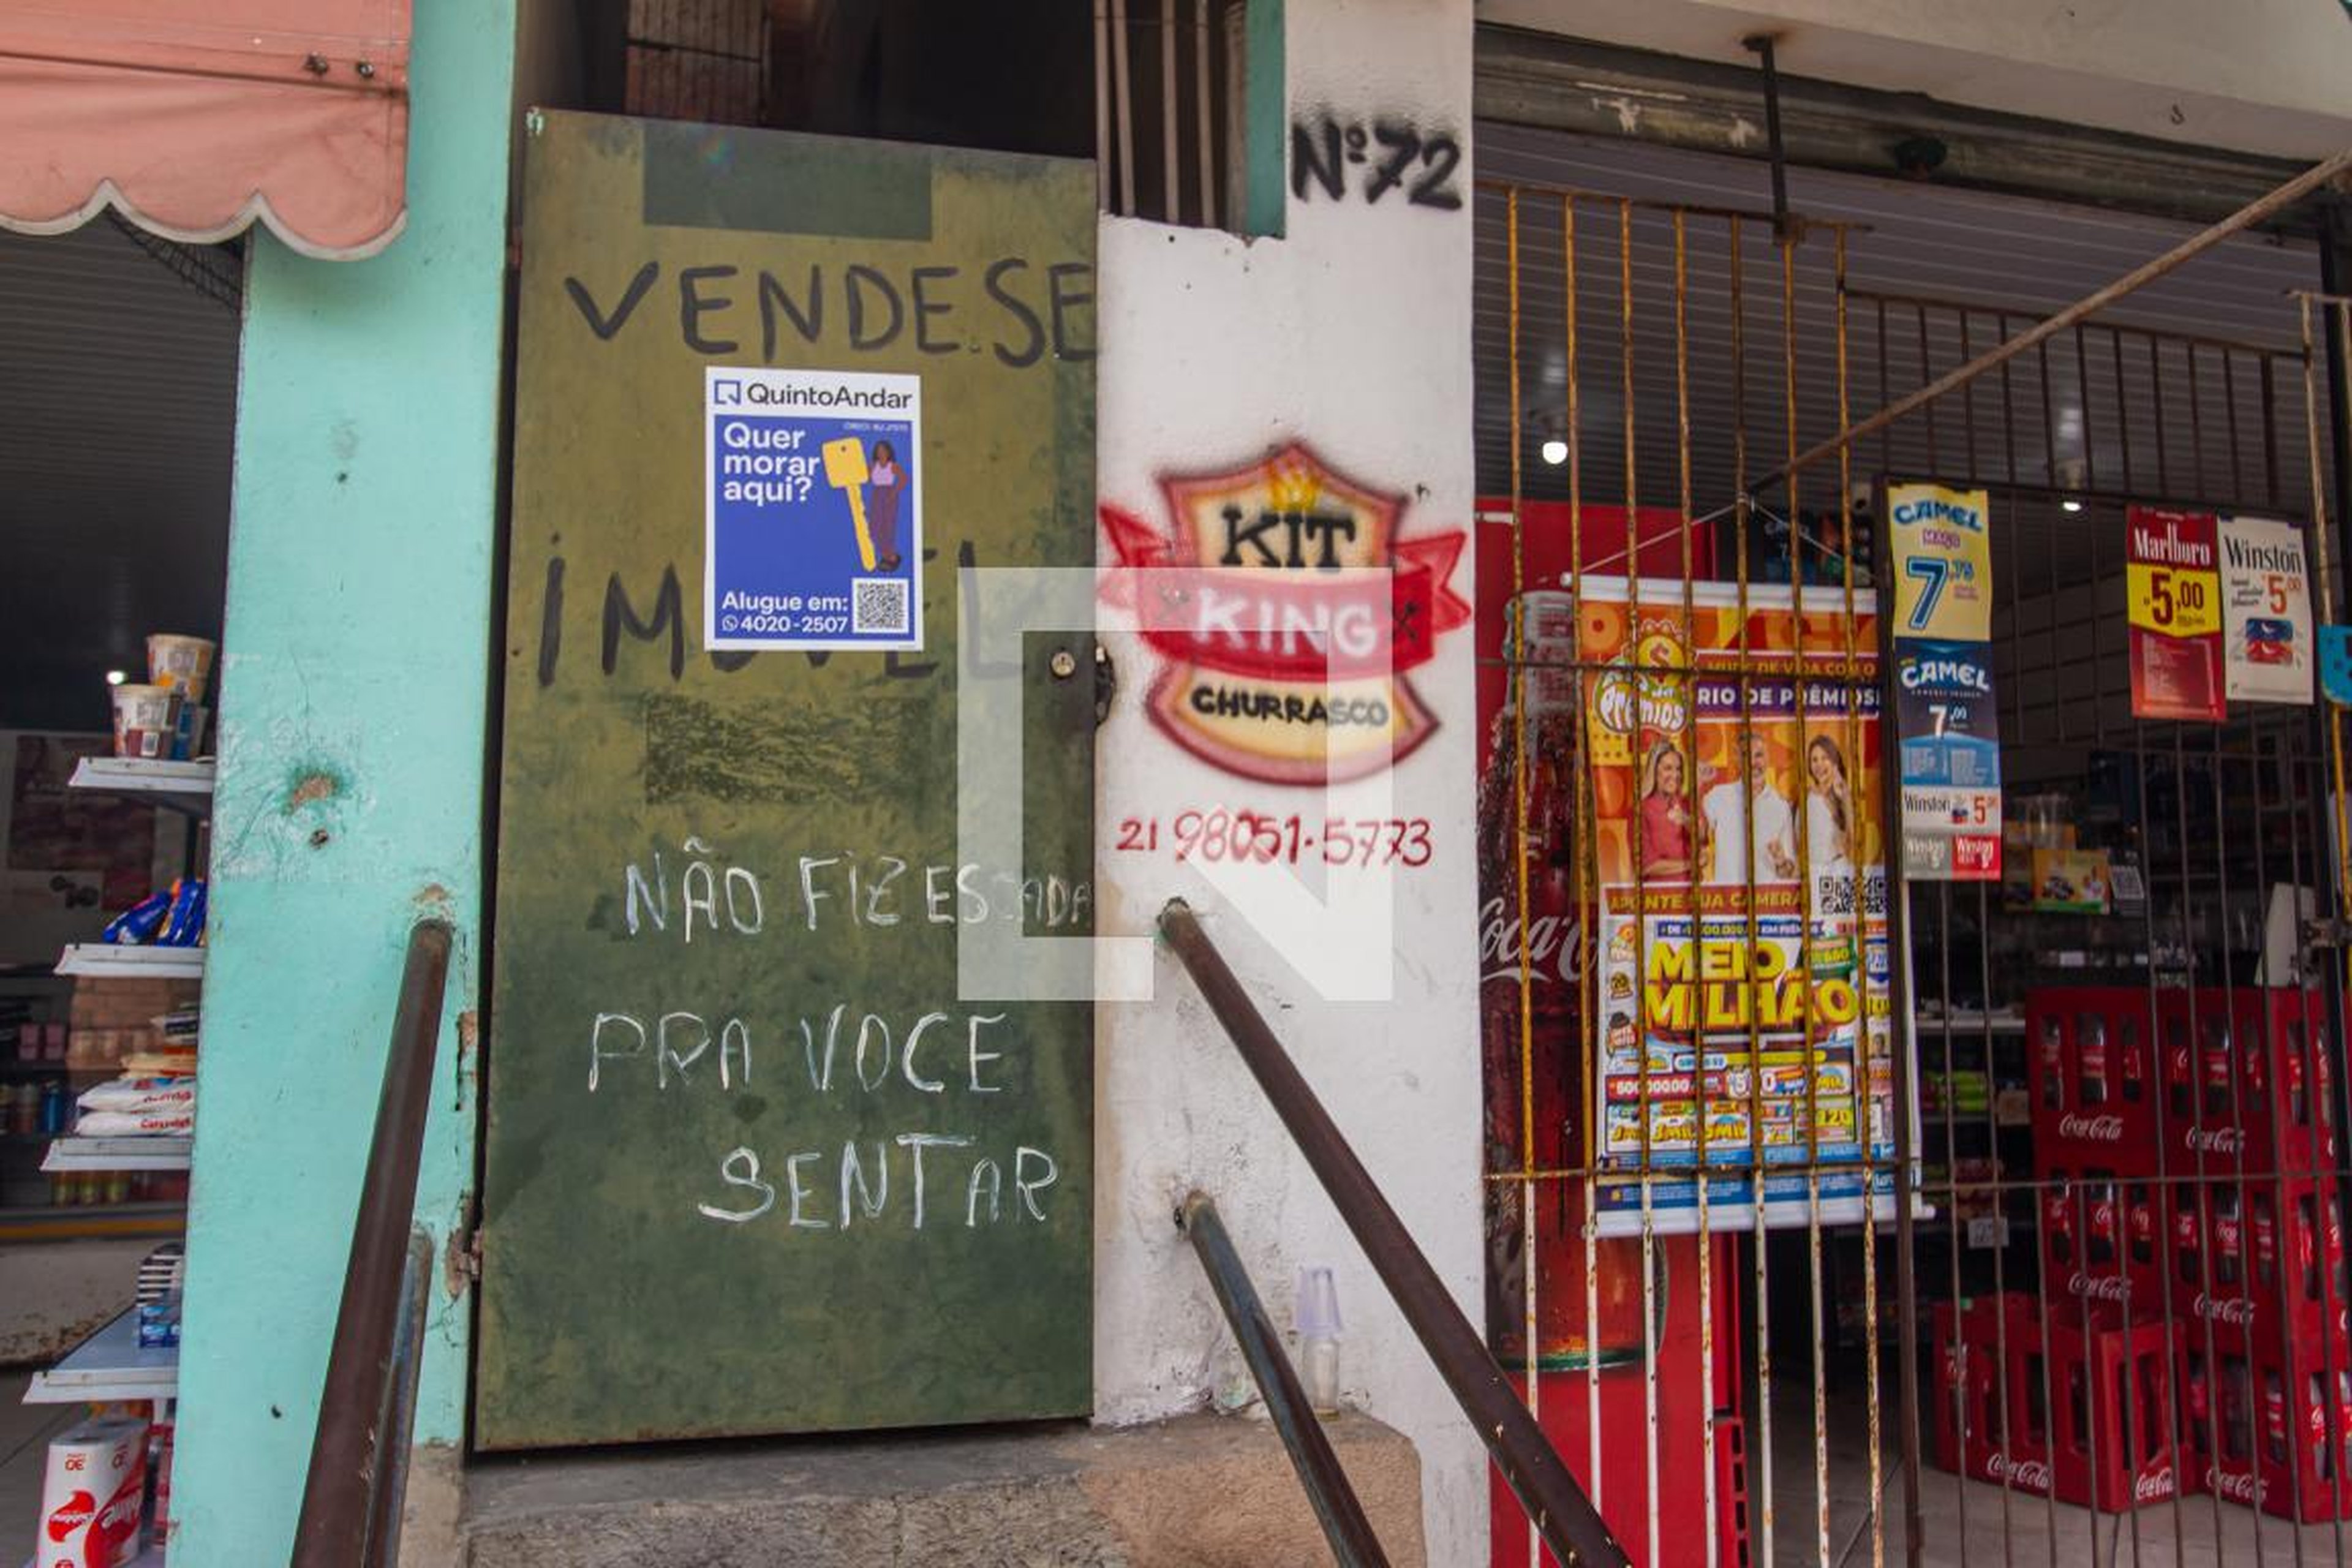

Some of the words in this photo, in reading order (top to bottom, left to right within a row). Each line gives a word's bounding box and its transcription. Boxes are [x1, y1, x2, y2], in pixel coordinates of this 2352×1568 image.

[747, 382, 913, 409] QuintoAndar
[723, 422, 806, 449] Quer
[723, 454, 820, 476] morar
[723, 475, 813, 507] aqui?
[1893, 499, 1983, 533] CAMEL
[1221, 503, 1356, 570] KIT
[2134, 522, 2211, 567] Marlboro
[2223, 534, 2302, 574] Winston
[722, 591, 802, 615] Alugue
[807, 597, 848, 611] em:
[1191, 586, 1379, 658] KING
[1901, 660, 1991, 693] CAMEL
[1191, 684, 1389, 728] CHURRASCO
[1697, 687, 1736, 705] RIO
[1116, 817, 1158, 851] 21
[625, 835, 764, 943] NÃO
[1648, 940, 1787, 982] MEIO
[588, 1011, 753, 1093] PRA
[800, 1003, 1009, 1093] VOCE
[697, 1133, 1059, 1231] SENTAR
